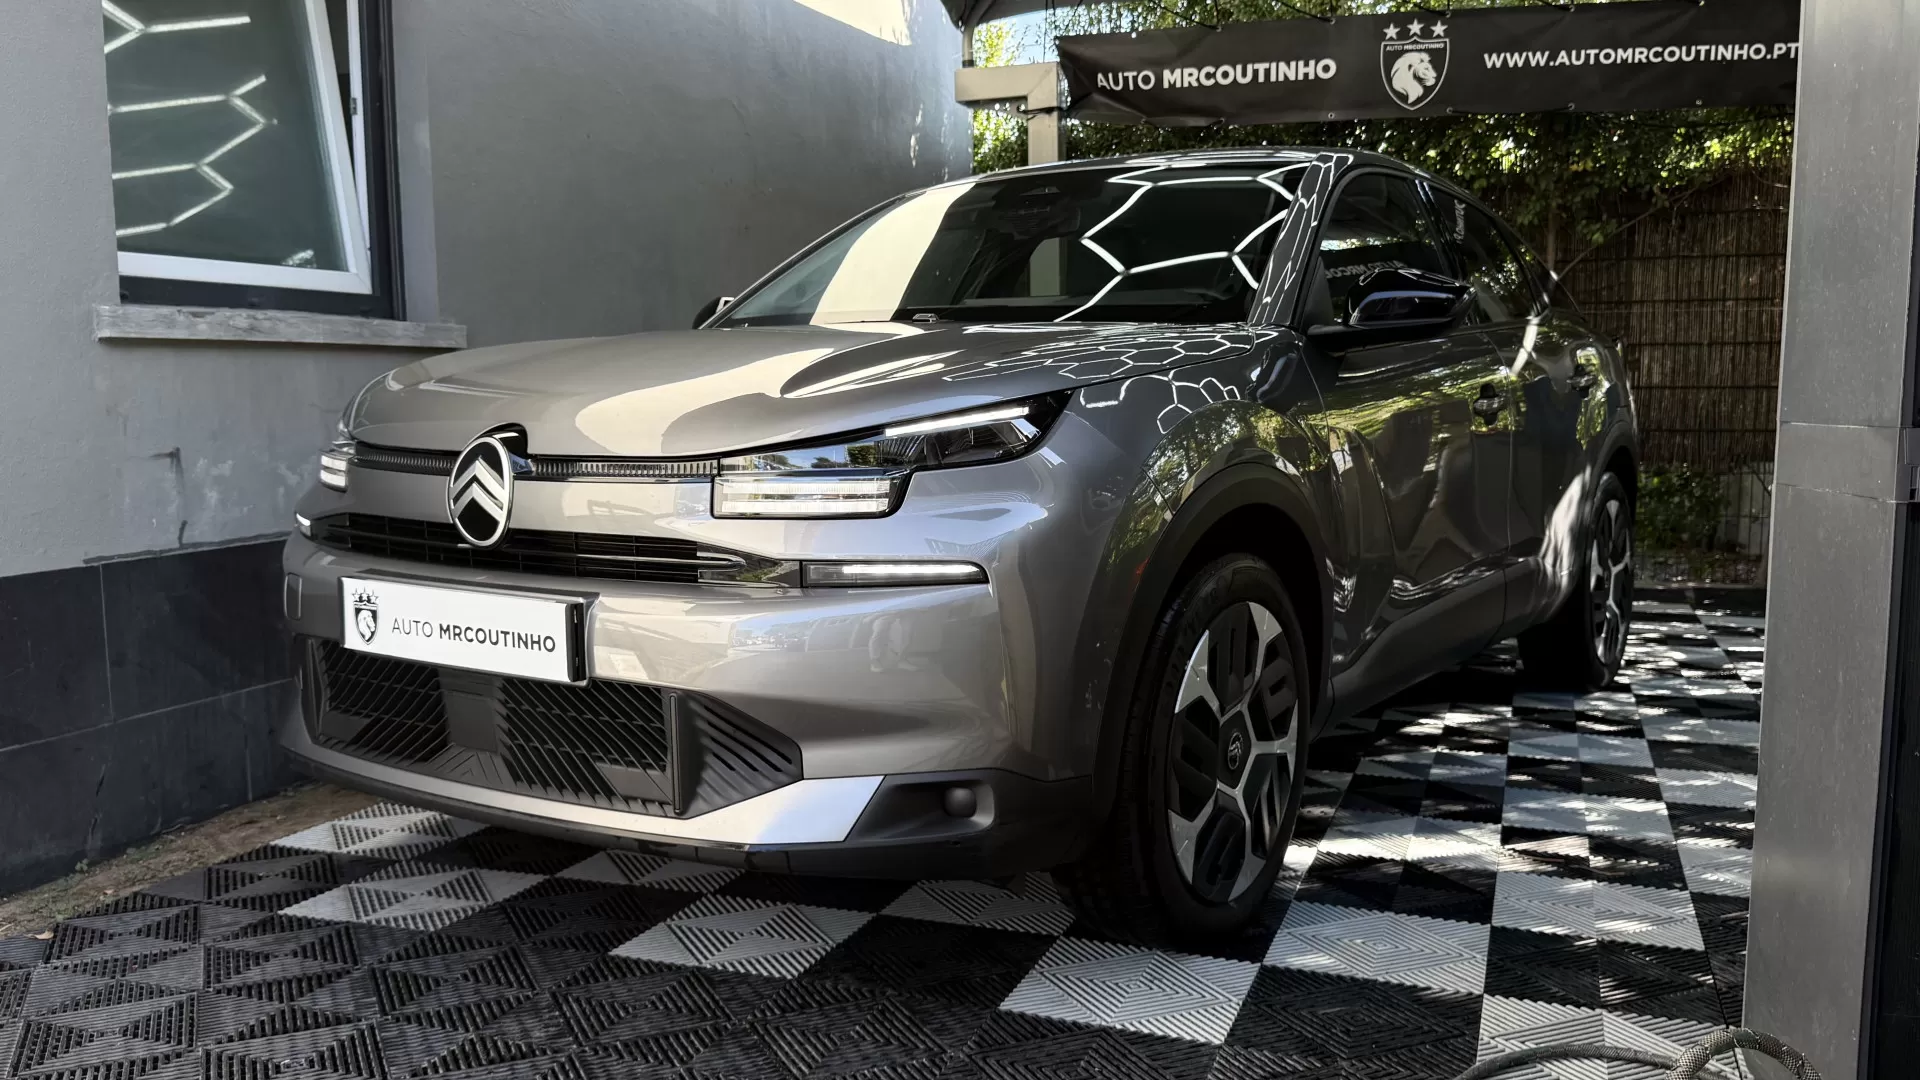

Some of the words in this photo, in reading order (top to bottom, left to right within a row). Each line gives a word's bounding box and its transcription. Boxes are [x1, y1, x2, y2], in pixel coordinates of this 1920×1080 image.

[1483, 42, 1800, 69] WWW.AUTOMRCOUTINHO.PT
[1097, 70, 1156, 91] AUTO
[1162, 58, 1337, 89] MRCOUTINHO
[391, 617, 434, 638] AUTO
[439, 623, 556, 653] MRCOUTINHO
